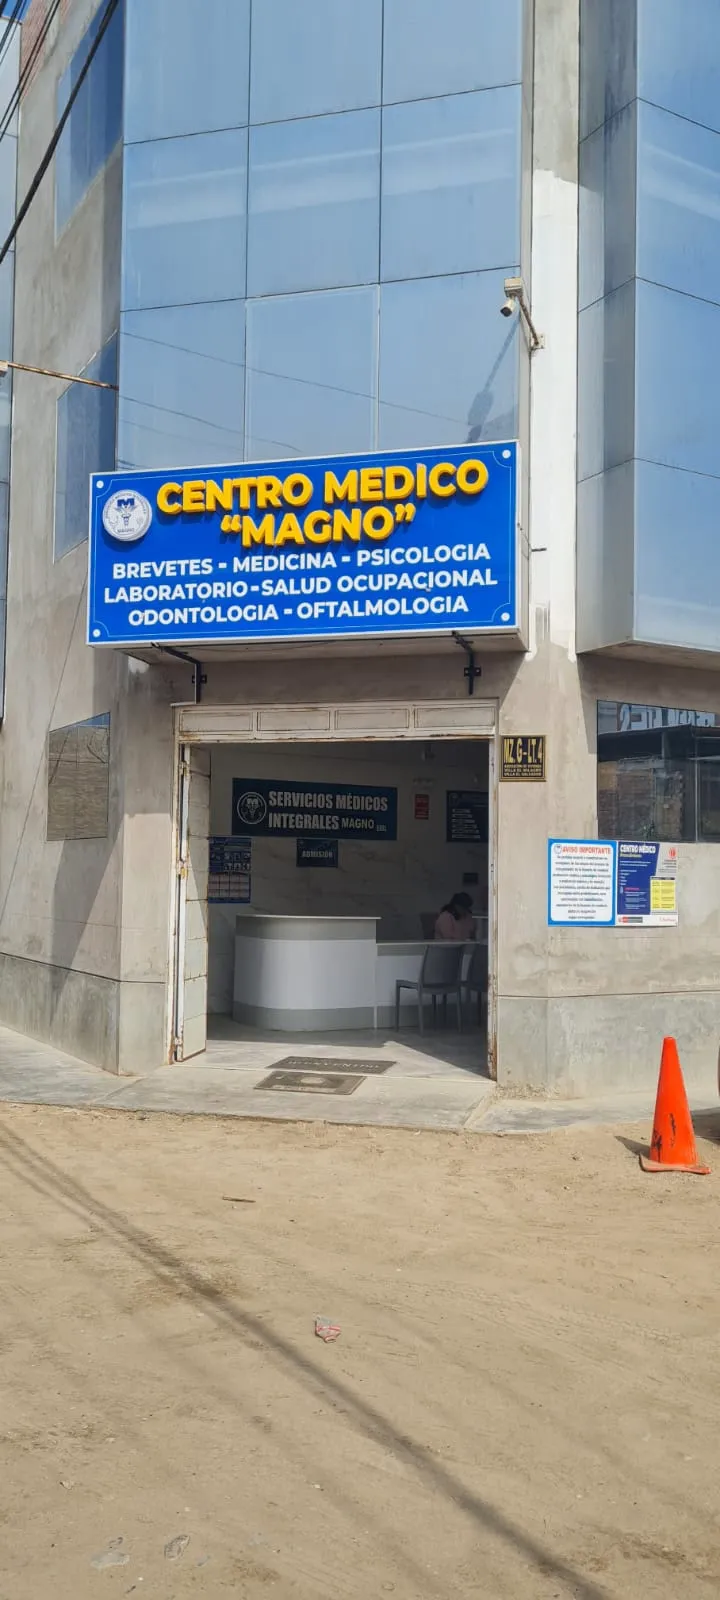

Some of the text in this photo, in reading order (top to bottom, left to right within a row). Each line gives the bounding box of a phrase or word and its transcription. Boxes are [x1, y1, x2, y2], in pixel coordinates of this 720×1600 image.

[157, 473, 313, 515] CENTRO
[324, 459, 488, 504] MEDICO
[220, 502, 416, 547] “MAGNO”
[113, 558, 213, 579] BREVETES
[233, 552, 337, 573] MEDICINA
[357, 543, 491, 567] PSICOLOGIA
[104, 581, 248, 603] LABORATORIO
[261, 577, 331, 596] SALUD
[337, 568, 498, 592] OCUPACIONAL
[128, 604, 279, 626] ODONTOLOGIA
[296, 595, 469, 620] OFTALMOLOGIA
[268, 791, 388, 811] SERVICIOS MÉDICOS
[268, 812, 339, 830] INTEGRALES
[341, 818, 375, 830] MAGNO
[562, 846, 611, 855] AVISO IMPORTANTE
[620, 844, 638, 853] CENTRO
